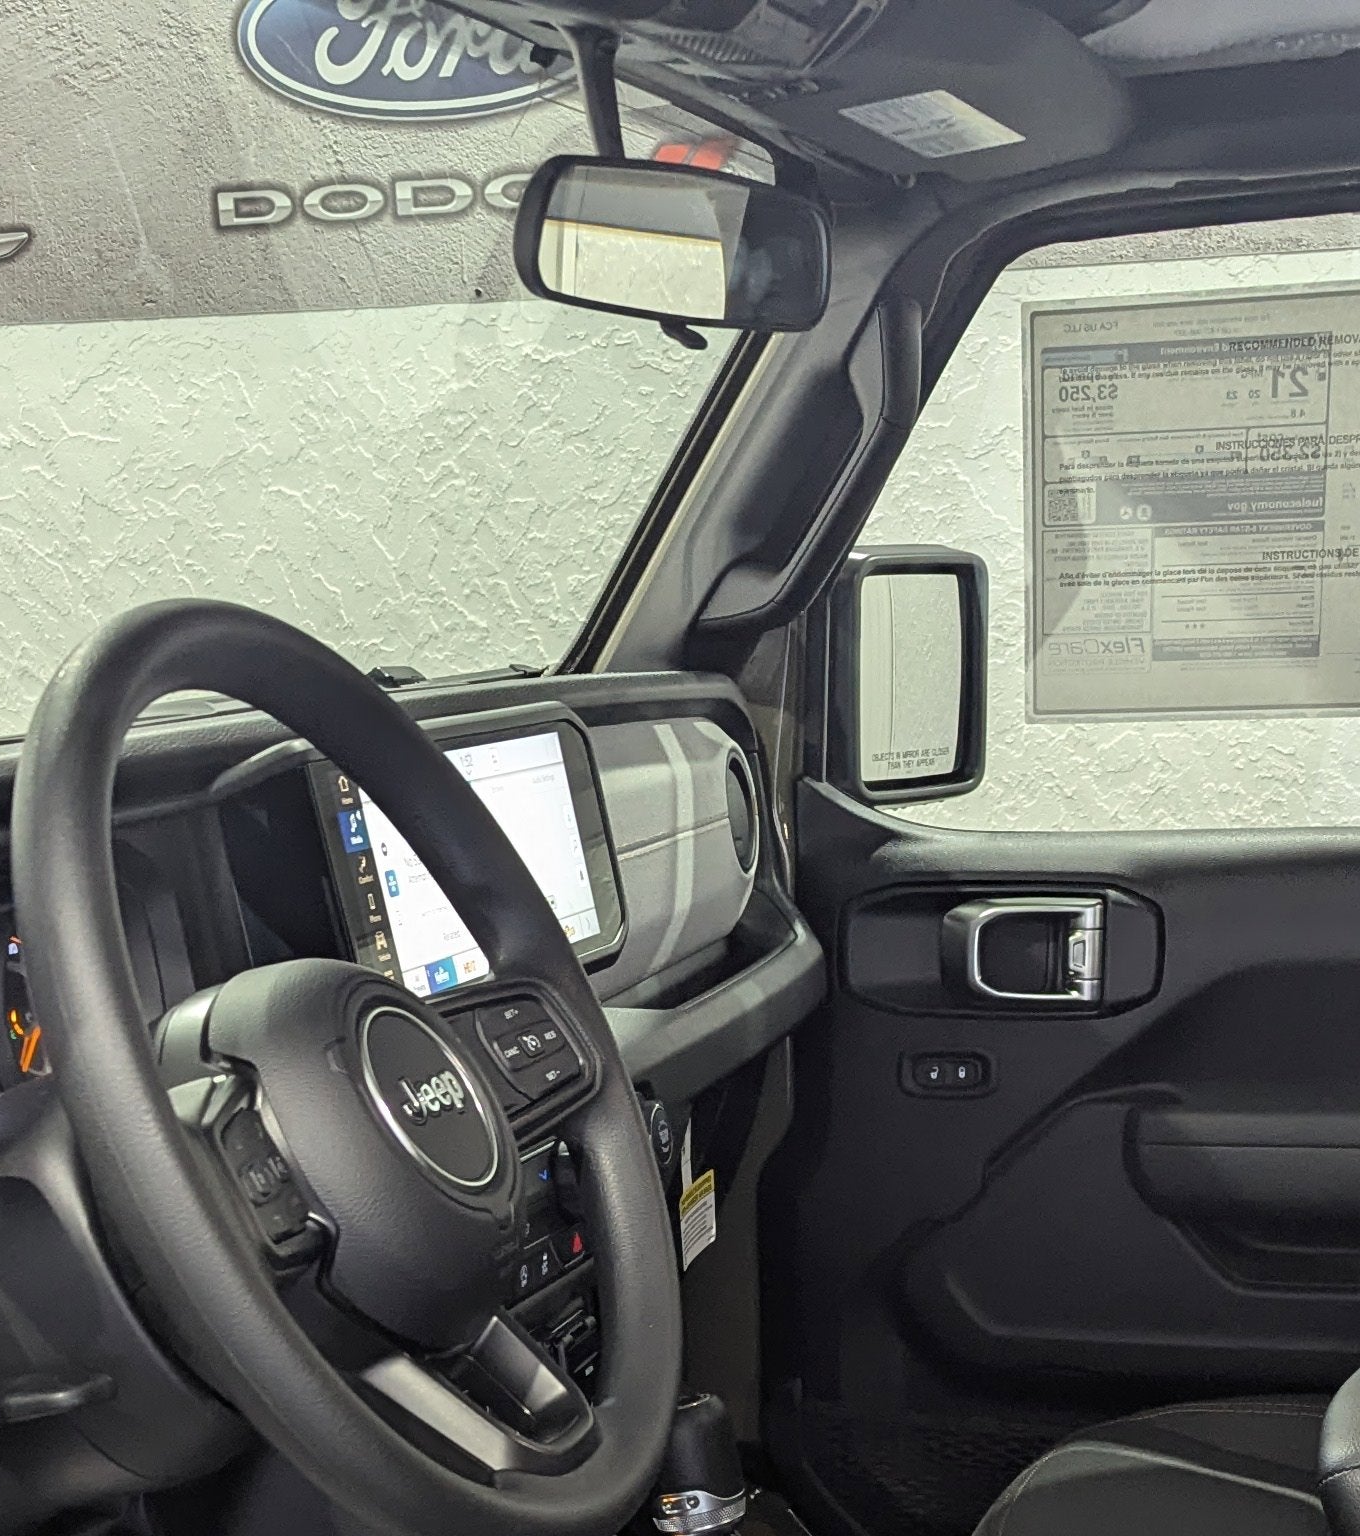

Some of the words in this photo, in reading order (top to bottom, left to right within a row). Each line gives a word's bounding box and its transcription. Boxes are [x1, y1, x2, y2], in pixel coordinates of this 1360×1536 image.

[217, 174, 533, 226] DOD
[1229, 336, 1316, 350] RECOMMENDED
[1216, 437, 1295, 450] INSTRUCCIONES
[1298, 435, 1326, 446] PARA
[1262, 549, 1342, 561] INSTRUCTIONS
[1343, 547, 1358, 558] DE
[401, 1071, 466, 1117] Jeep
